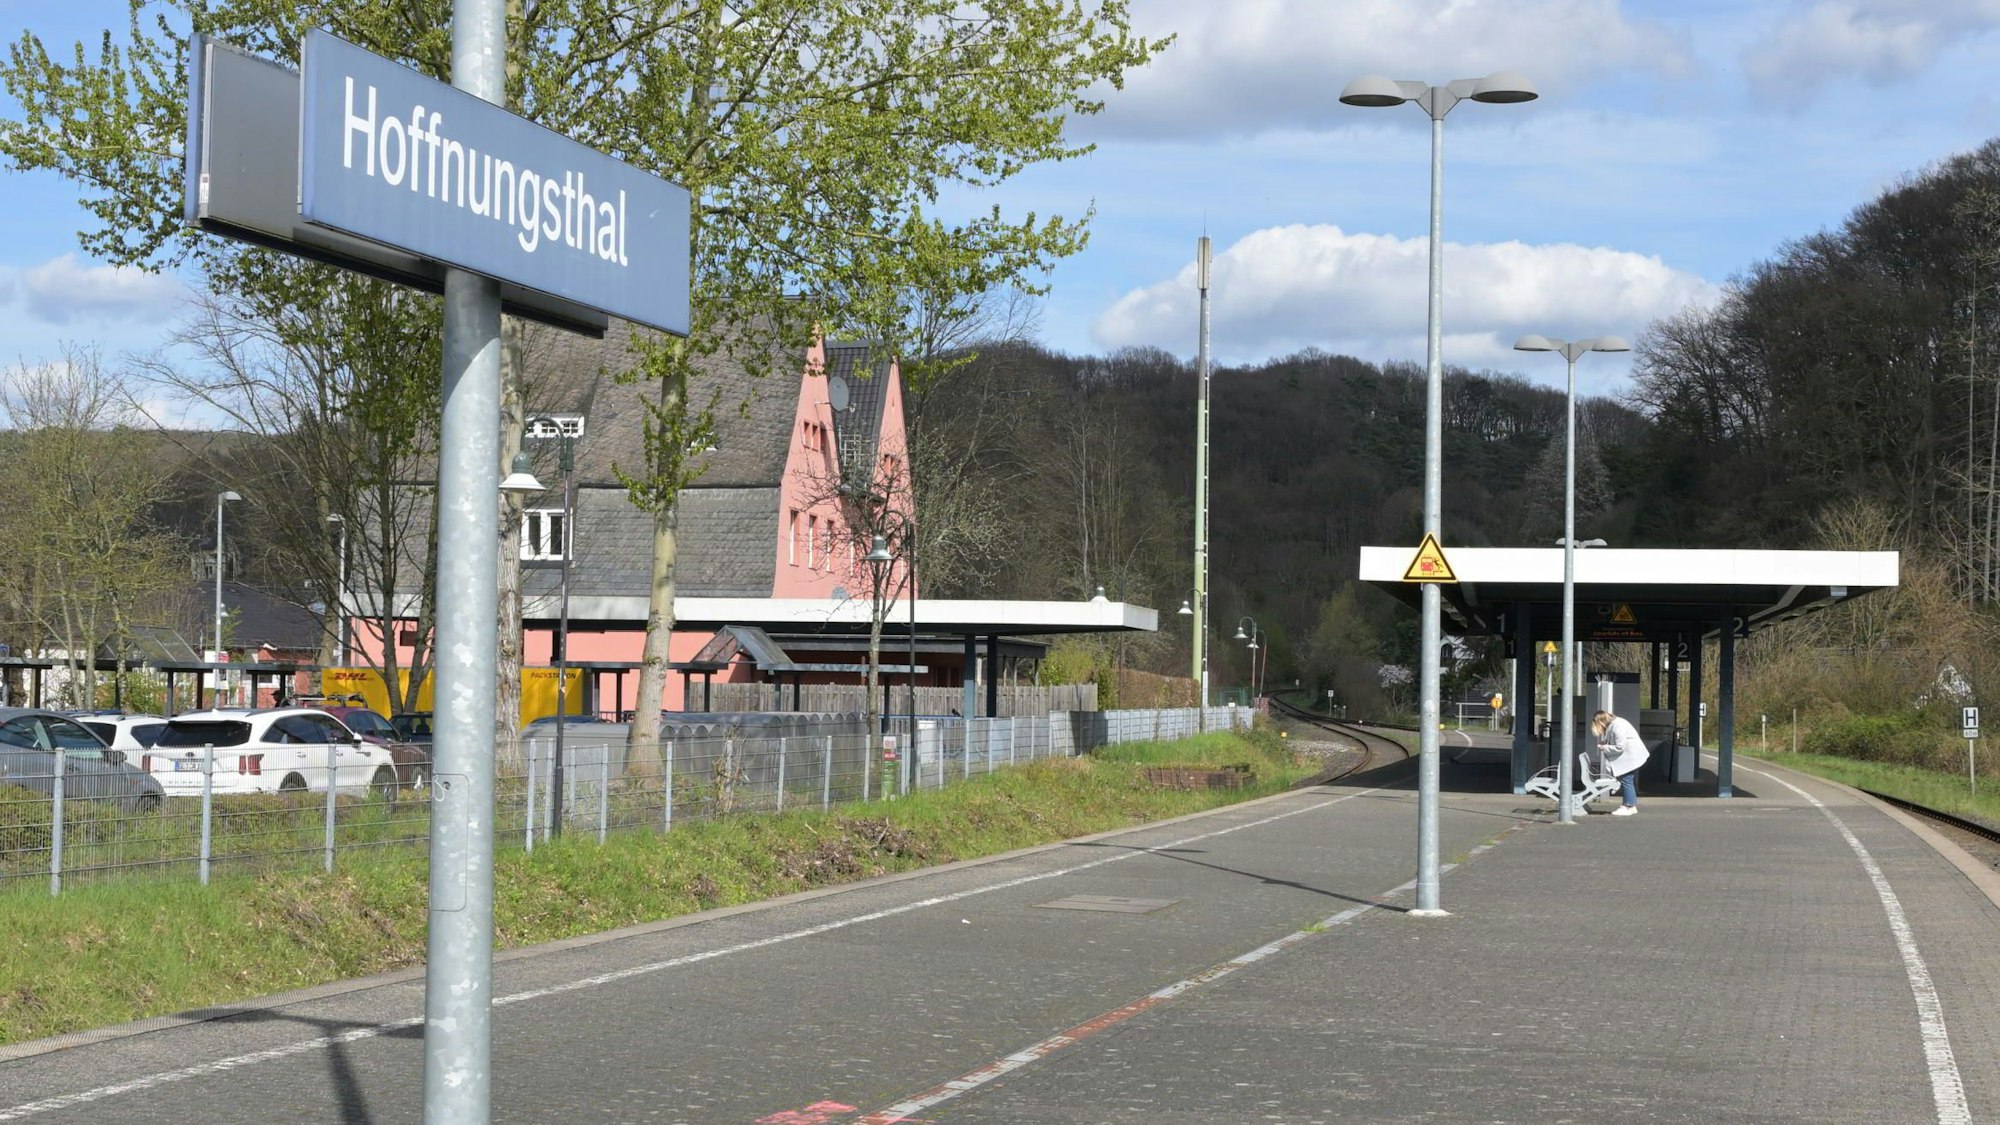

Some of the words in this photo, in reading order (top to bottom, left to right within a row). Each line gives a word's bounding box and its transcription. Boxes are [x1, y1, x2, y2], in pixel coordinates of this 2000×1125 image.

[343, 76, 628, 267] Hoffnungsthal
[1496, 613, 1506, 633] 1
[1733, 617, 1744, 637] 2
[1506, 639, 1515, 656] 1
[1677, 643, 1689, 658] 2
[335, 672, 367, 680] DHL
[1965, 709, 1977, 726] H
